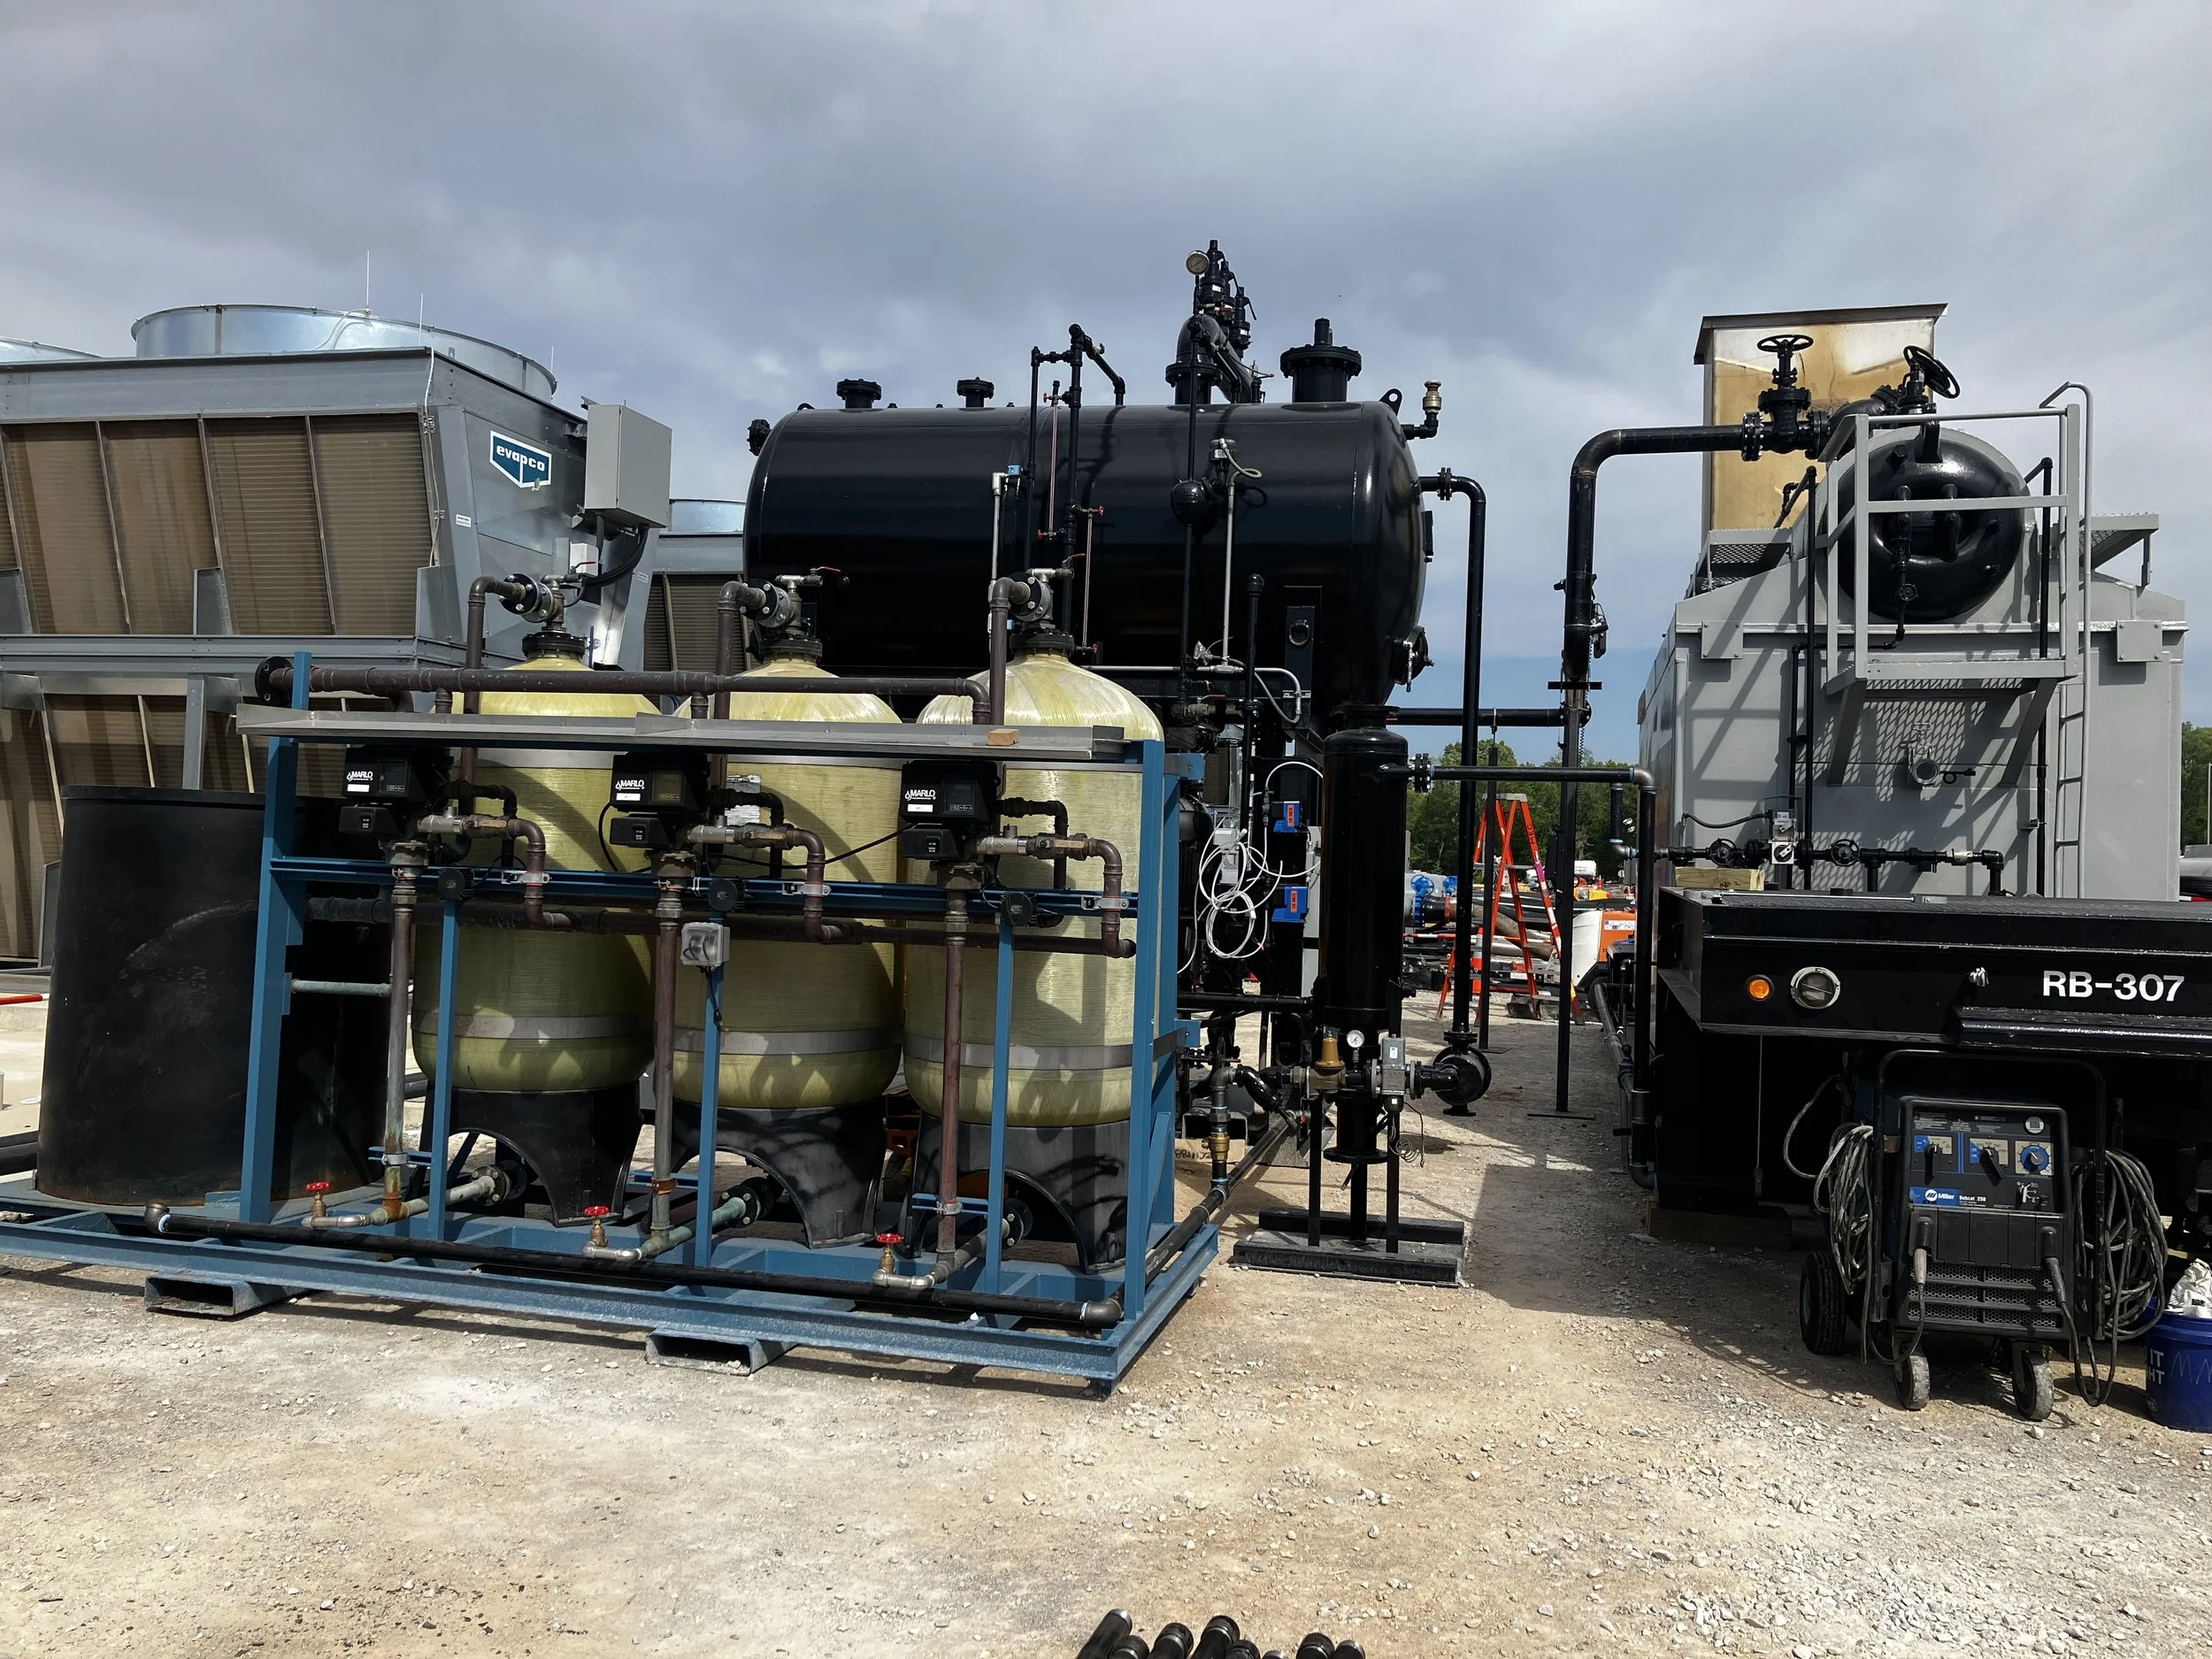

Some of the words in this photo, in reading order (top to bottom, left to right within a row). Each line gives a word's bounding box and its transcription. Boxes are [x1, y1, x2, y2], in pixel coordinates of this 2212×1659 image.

[495, 444, 545, 472] evapco
[350, 771, 373, 780] MARLO
[620, 780, 645, 788] MARLO
[910, 789, 936, 798] MARLO
[2043, 971, 2185, 1002] RB-307
